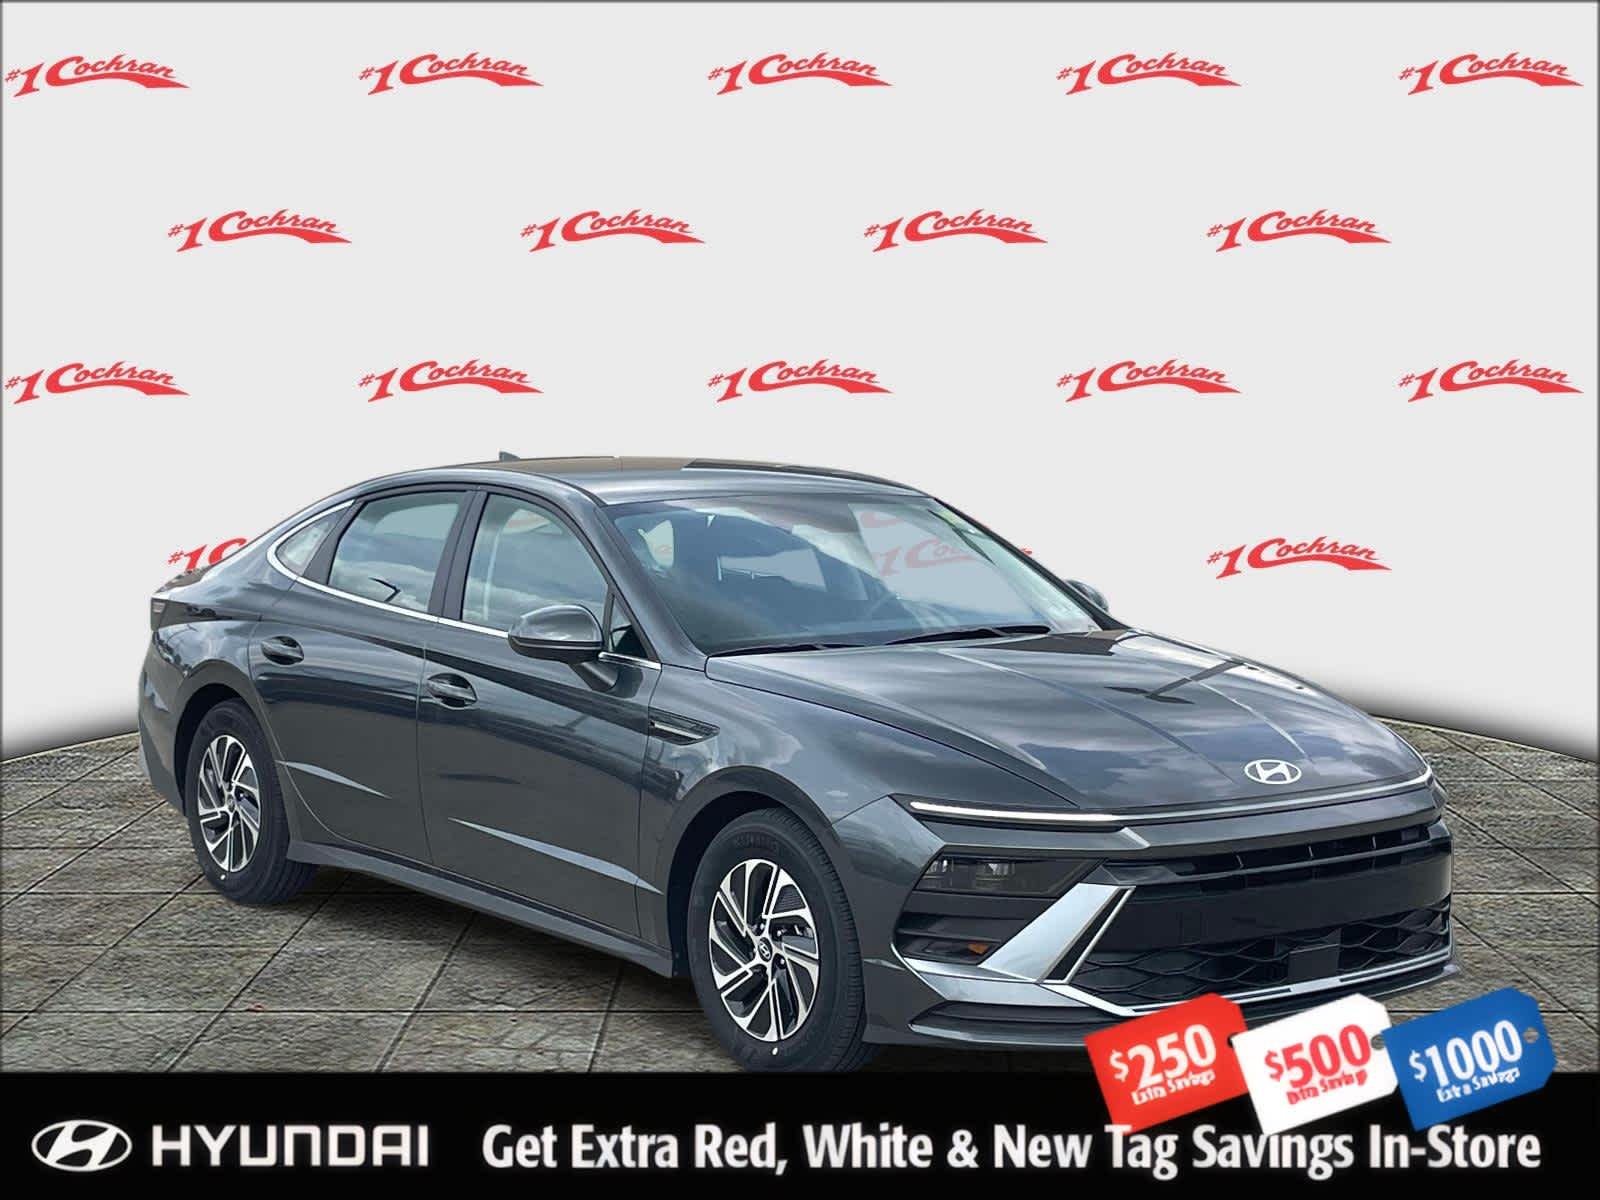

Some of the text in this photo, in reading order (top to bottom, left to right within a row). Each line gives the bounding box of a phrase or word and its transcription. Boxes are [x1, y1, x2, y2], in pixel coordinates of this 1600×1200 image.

[6, 54, 186, 97] #1 Cochran
[360, 52, 540, 95] #1 Cochran
[709, 52, 889, 95] #1 Cochran
[1057, 52, 1237, 95] #1 Cochran
[1400, 53, 1580, 96] #1 Cochran
[169, 210, 349, 253] #1 Cochran
[522, 209, 702, 252] #1 Cochran
[865, 209, 1045, 252] #1 Cochran
[1209, 209, 1389, 252] #1 Cochran
[6, 361, 186, 404] #1 Cochran
[360, 359, 540, 402] #1 Cochran
[709, 359, 889, 402] #1 Cochran
[1057, 359, 1237, 402] #1 Cochran
[1400, 359, 1580, 402] #1 Cochran
[1208, 536, 1388, 579] #1 Cochran
